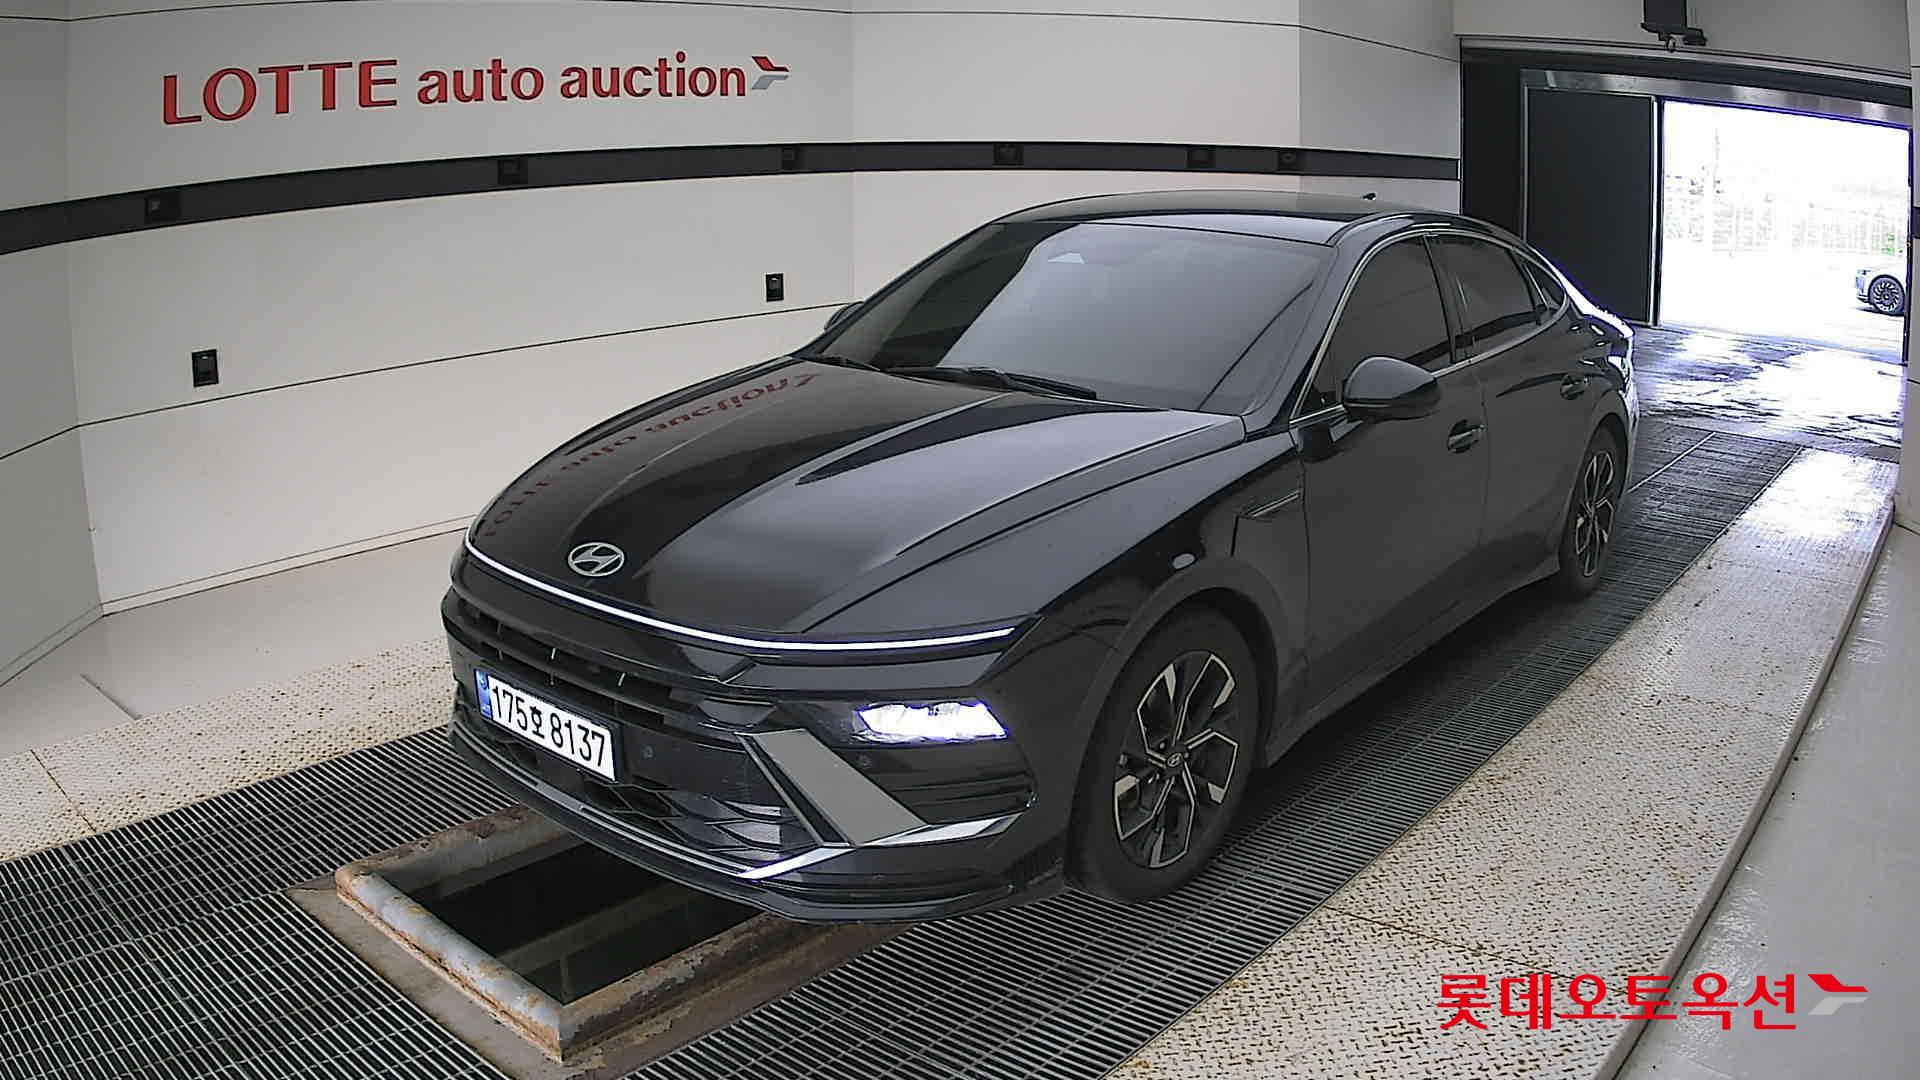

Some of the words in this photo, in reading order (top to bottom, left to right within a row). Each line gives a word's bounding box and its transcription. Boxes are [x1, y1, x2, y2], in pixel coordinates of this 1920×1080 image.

[163, 60, 398, 125] LOTTE
[417, 58, 544, 104] auto
[560, 51, 747, 98] auction
[549, 711, 606, 768] 8137
